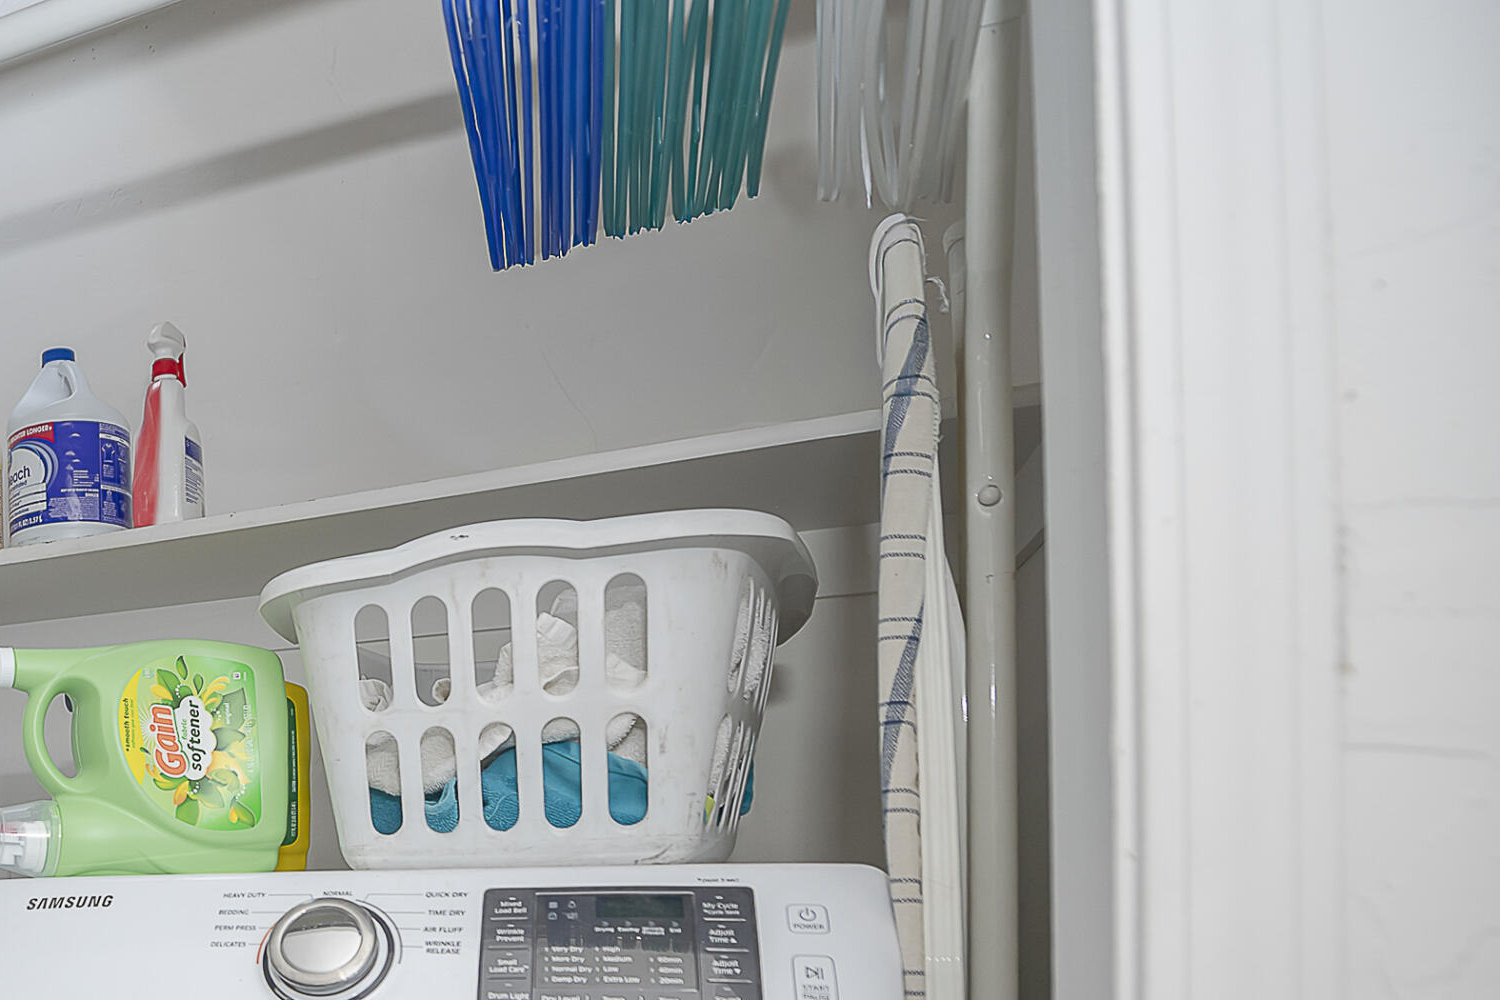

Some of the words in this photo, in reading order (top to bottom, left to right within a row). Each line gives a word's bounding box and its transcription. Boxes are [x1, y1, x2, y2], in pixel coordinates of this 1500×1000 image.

[149, 705, 188, 776] Gain
[188, 699, 207, 772] softener
[26, 894, 114, 911] SAMSUNG
